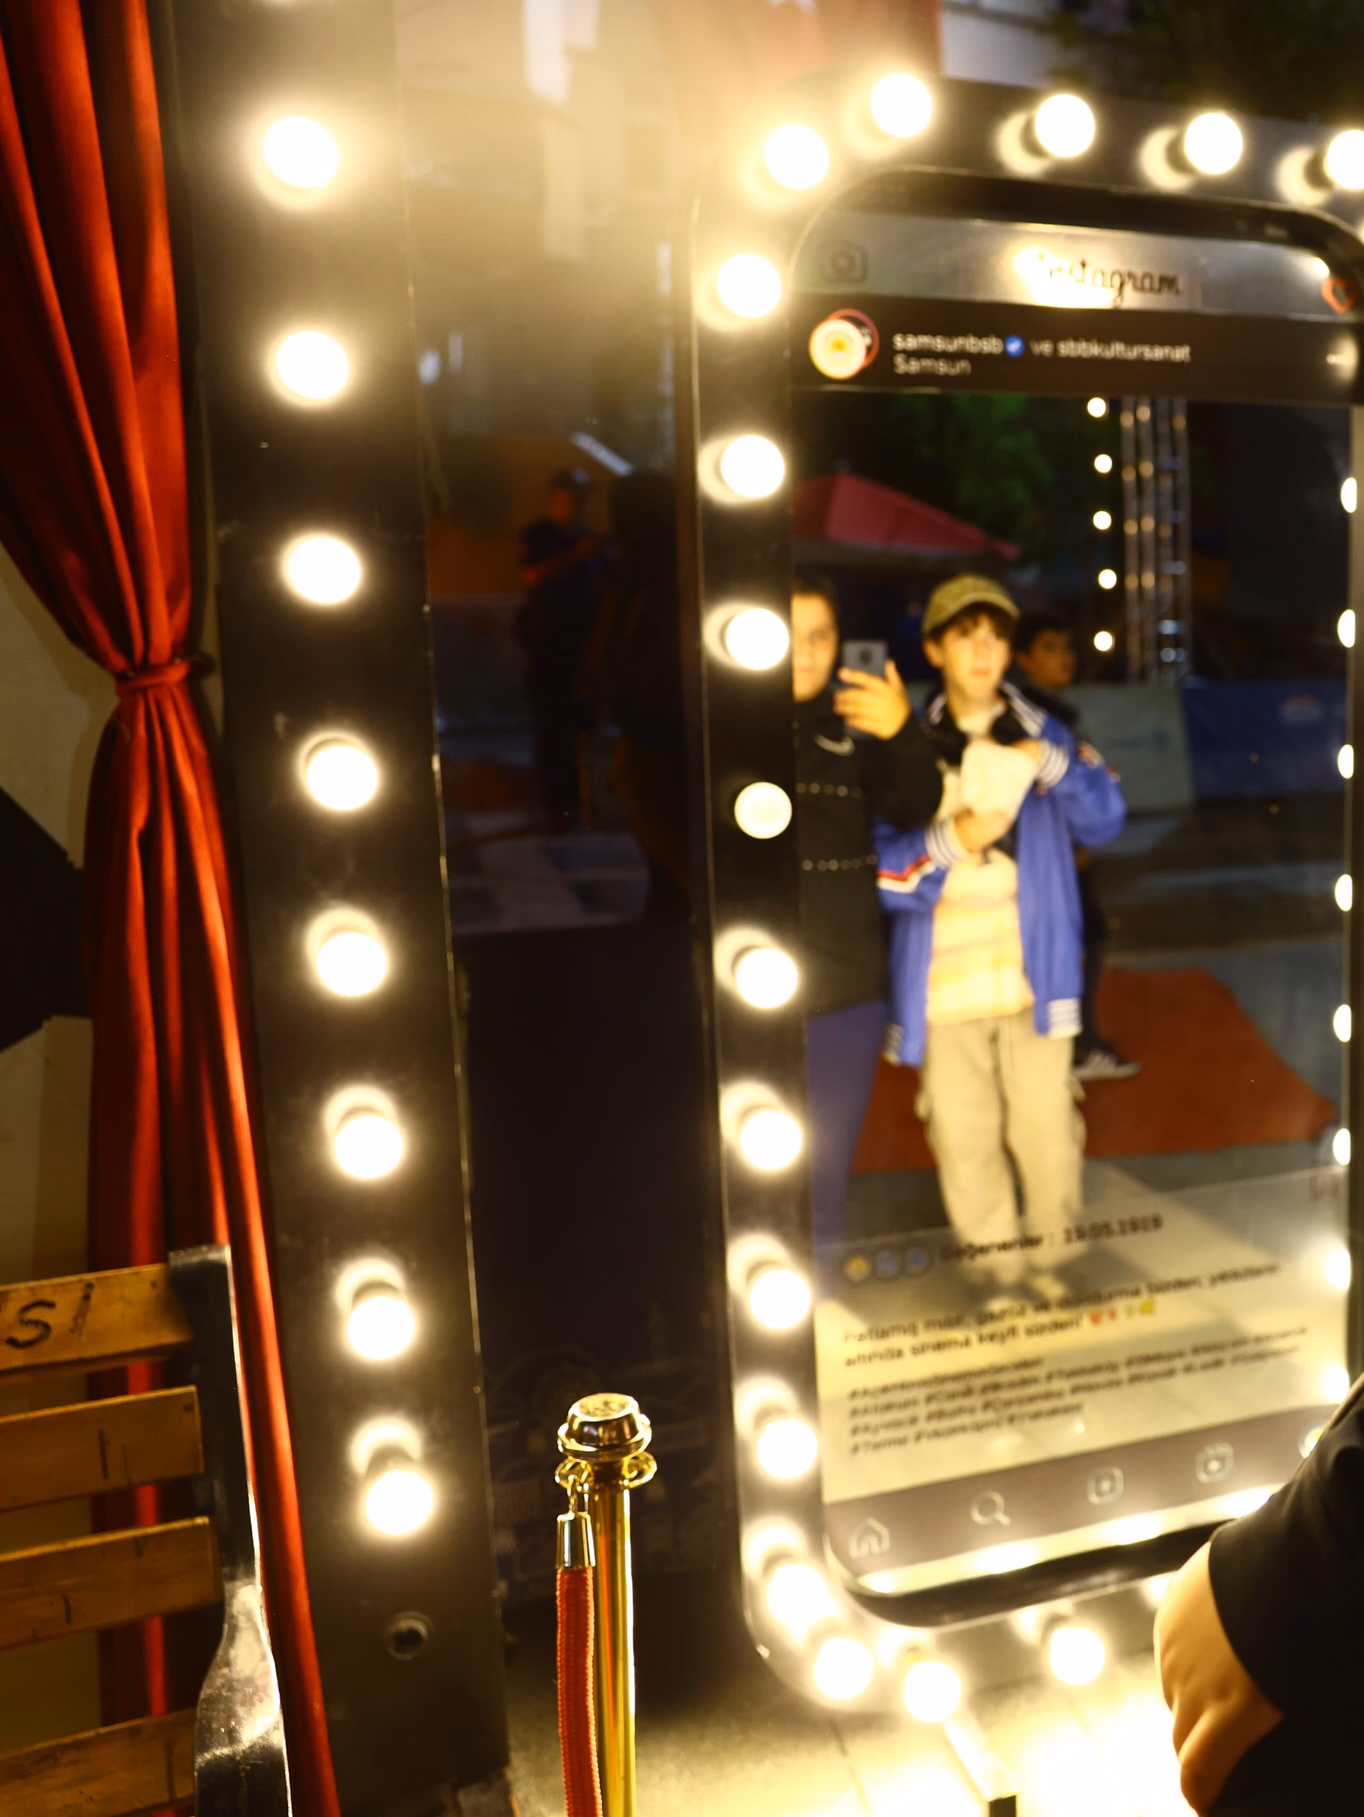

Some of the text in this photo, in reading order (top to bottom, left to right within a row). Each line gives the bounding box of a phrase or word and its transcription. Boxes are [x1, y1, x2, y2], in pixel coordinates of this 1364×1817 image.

[893, 333, 1003, 355] samsunbsb
[1029, 340, 1054, 356] ve
[894, 353, 971, 376] Samsun
